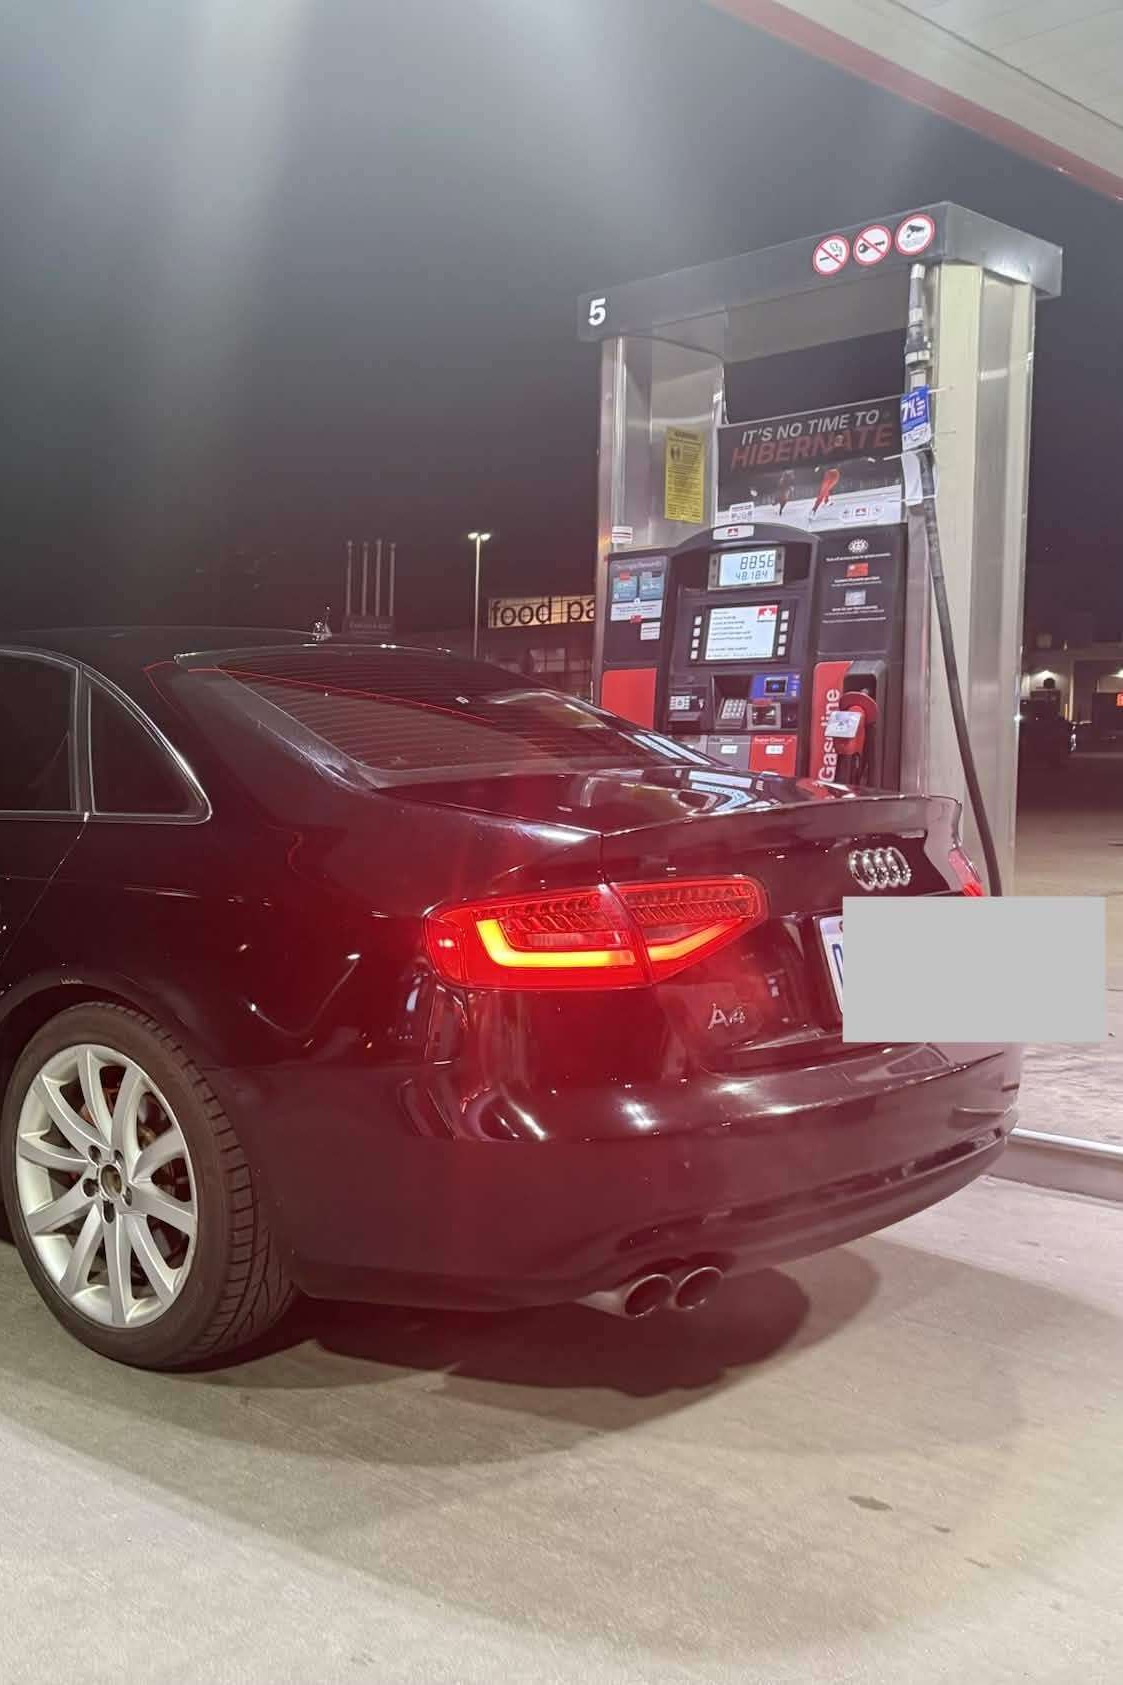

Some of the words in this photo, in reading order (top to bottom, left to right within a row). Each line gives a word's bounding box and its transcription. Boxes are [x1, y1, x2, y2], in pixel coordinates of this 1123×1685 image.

[588, 297, 606, 326] 5
[741, 426, 773, 446] IT'S
[776, 423, 803, 440] NO
[808, 413, 849, 434] TIME
[854, 409, 880, 427] TO
[731, 424, 894, 469] HIBERNATE
[491, 597, 552, 626] food
[817, 688, 841, 782] Gasne
[707, 1003, 746, 1030] A4
